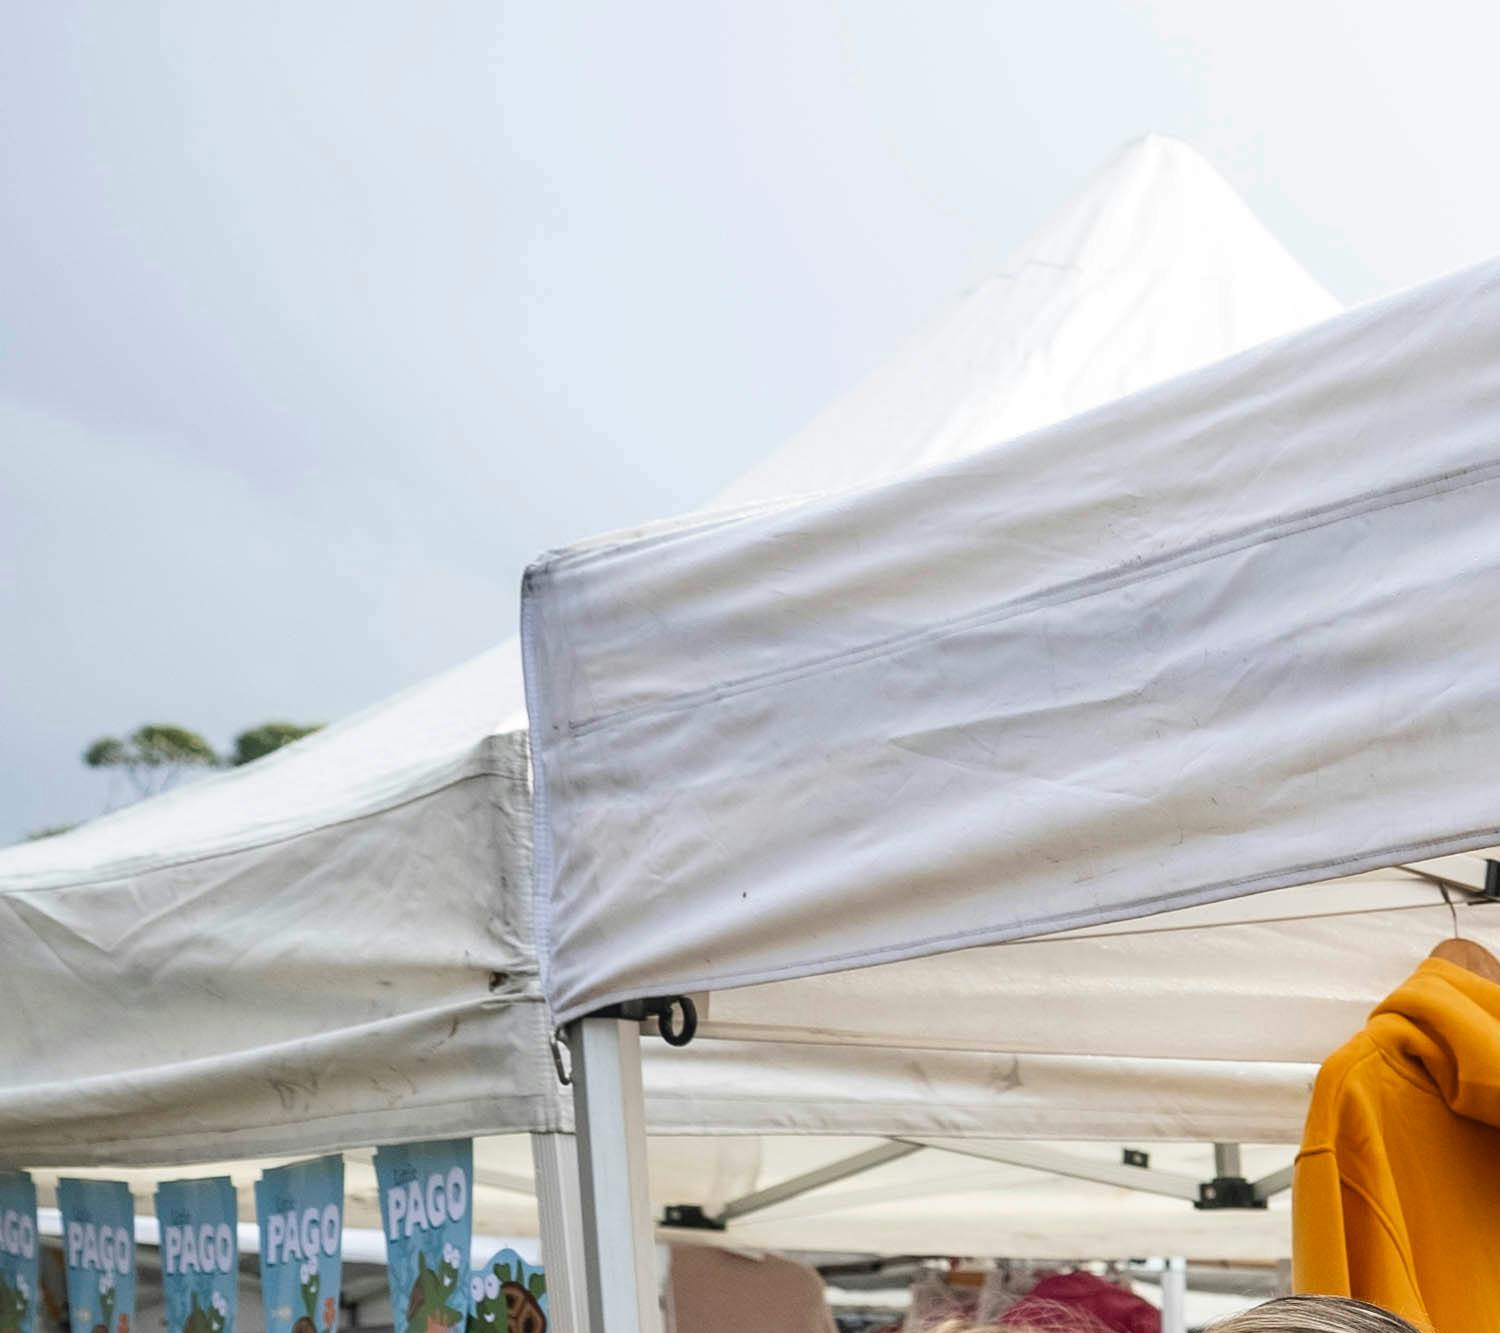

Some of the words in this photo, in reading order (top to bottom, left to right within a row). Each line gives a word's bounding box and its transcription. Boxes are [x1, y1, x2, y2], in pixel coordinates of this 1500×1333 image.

[387, 1167, 466, 1242] PAGO
[67, 1222, 130, 1275] PAGO
[164, 1223, 232, 1275] PAGO
[267, 1204, 340, 1266] PAGO
